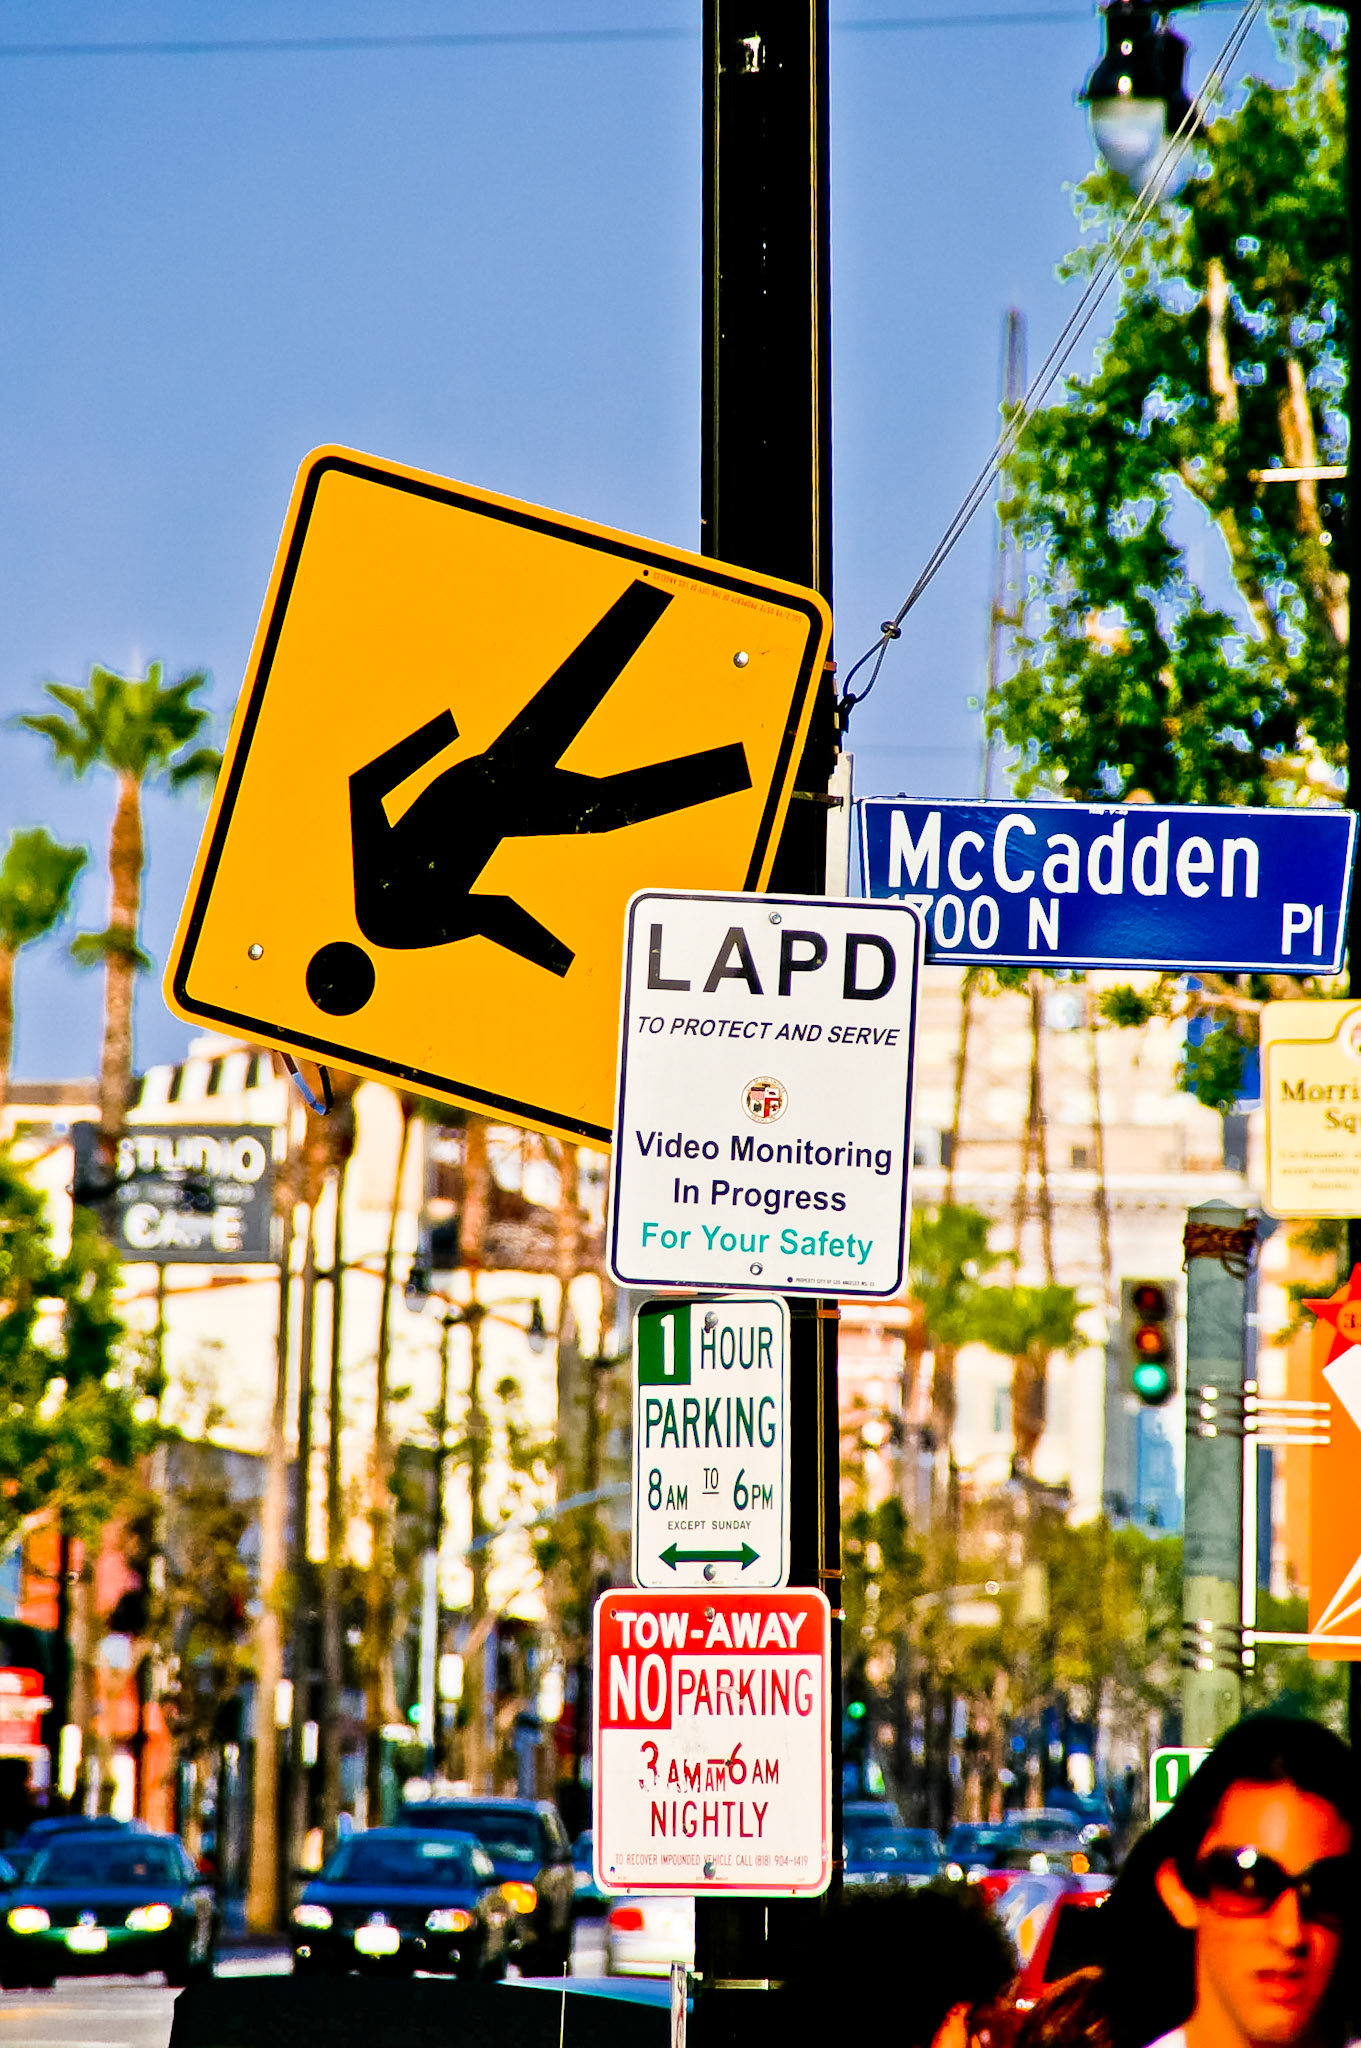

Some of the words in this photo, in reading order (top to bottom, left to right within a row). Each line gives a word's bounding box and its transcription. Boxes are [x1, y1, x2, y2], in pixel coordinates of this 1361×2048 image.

[888, 810, 1259, 899] McCadden
[887, 894, 999, 949] 700
[1028, 898, 1059, 950] N
[647, 923, 897, 1000] LAPD
[638, 1016, 664, 1034] TO
[670, 1018, 772, 1040] PROTECT
[775, 1023, 822, 1042] AND
[828, 1025, 900, 1046] SERVE
[1279, 1077, 1361, 1103] Morri
[1322, 1106, 1361, 1135] Sq
[635, 1131, 719, 1160] Video
[730, 1135, 892, 1176] Monitoring
[673, 1178, 699, 1204] In
[711, 1180, 847, 1215] Progress
[642, 1222, 691, 1249] For
[701, 1226, 769, 1253] Your
[780, 1228, 873, 1265] Safety
[661, 1314, 675, 1376] 1
[701, 1326, 773, 1370] HOUR
[645, 1395, 776, 1448] PARKING
[703, 1468, 719, 1491] TO
[667, 1520, 705, 1530] EXCEPT
[712, 1520, 751, 1530] SUNDAY
[615, 1612, 808, 1649] TOW-AWAY
[610, 1653, 667, 1722] NO
[678, 1668, 813, 1716] PARKING
[1166, 1759, 1179, 1798] 1
[651, 1800, 769, 1838] NIGHTLY
[616, 1854, 623, 1865] TO
[627, 1854, 657, 1865] RECOVER
[661, 1854, 700, 1865] IMPOUNDED
[703, 1854, 732, 1866] VEHICLE
[736, 1855, 753, 1867] CALL
[755, 1855, 771, 1867] (818)
[774, 1855, 808, 1867] 904-1419
